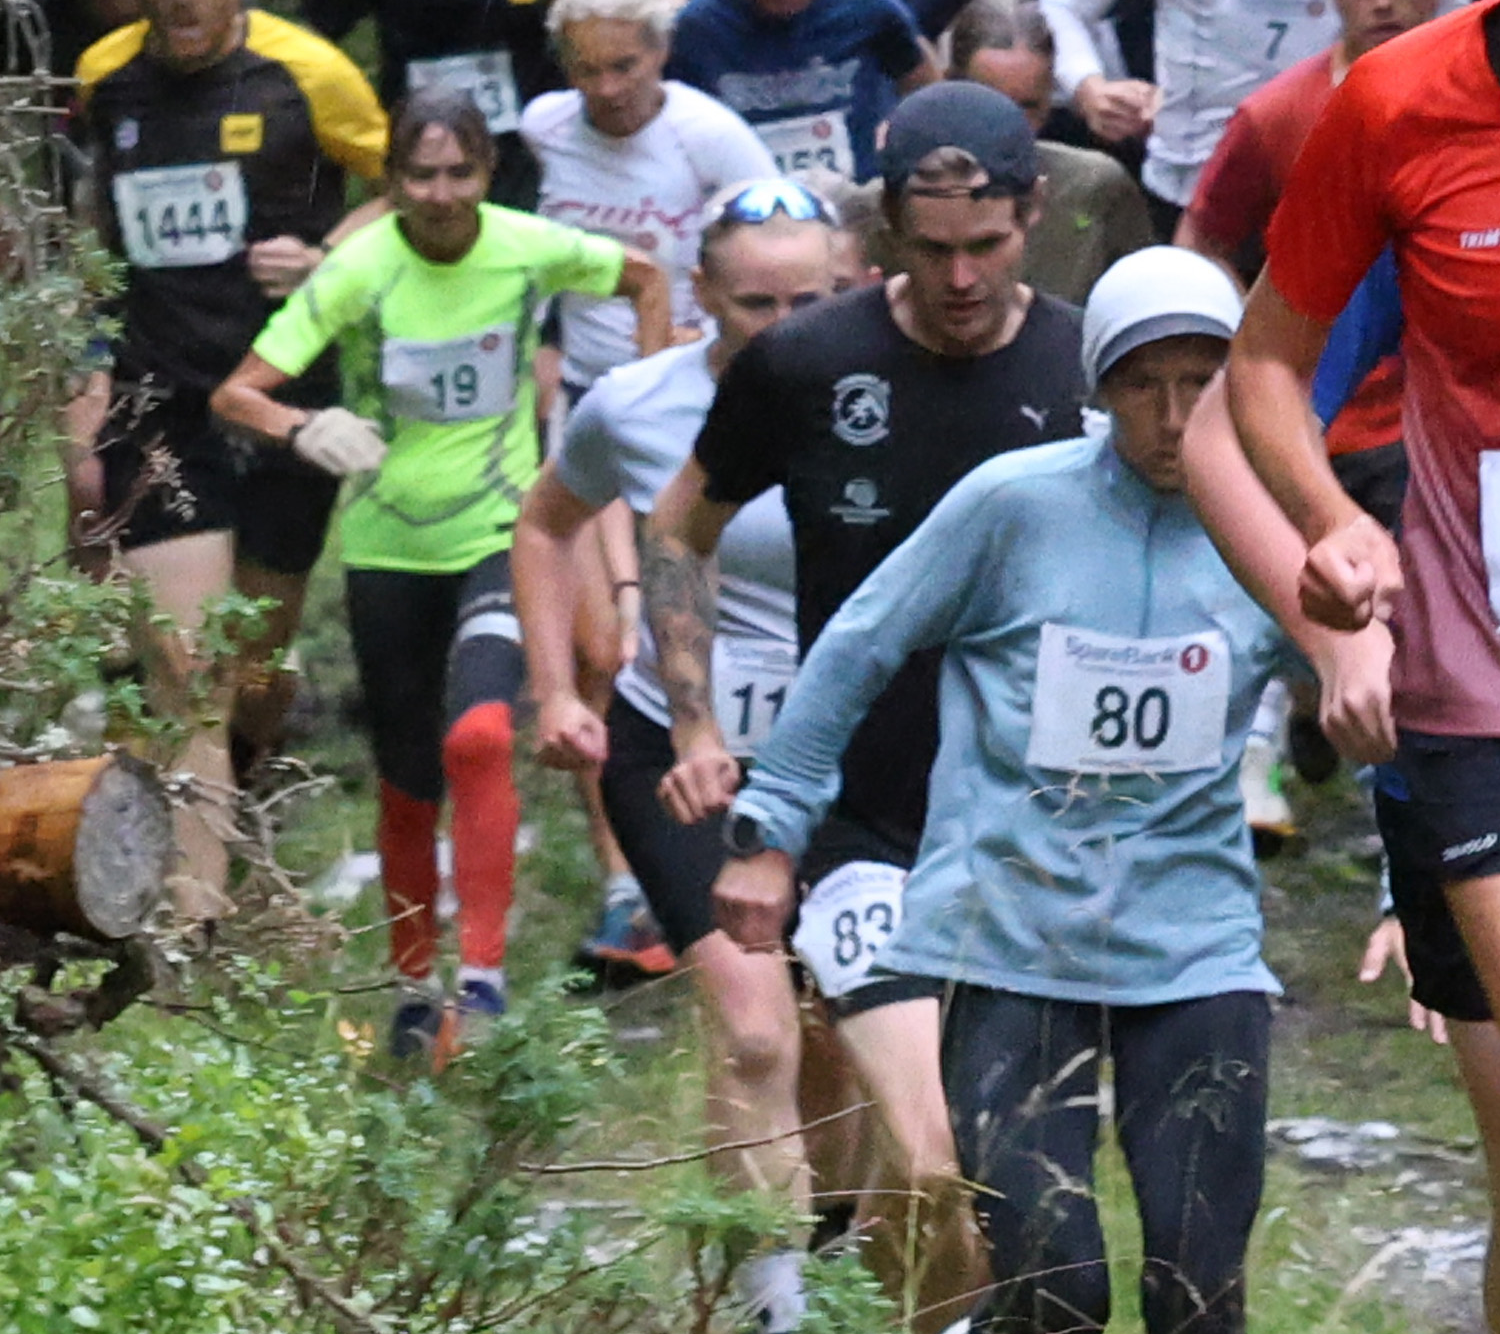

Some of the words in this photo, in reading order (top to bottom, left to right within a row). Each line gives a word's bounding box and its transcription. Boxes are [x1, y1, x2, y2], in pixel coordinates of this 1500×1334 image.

[1266, 21, 1289, 61] 7
[136, 199, 232, 249] 1444
[430, 364, 479, 412] 19
[1090, 685, 1170, 749] 80
